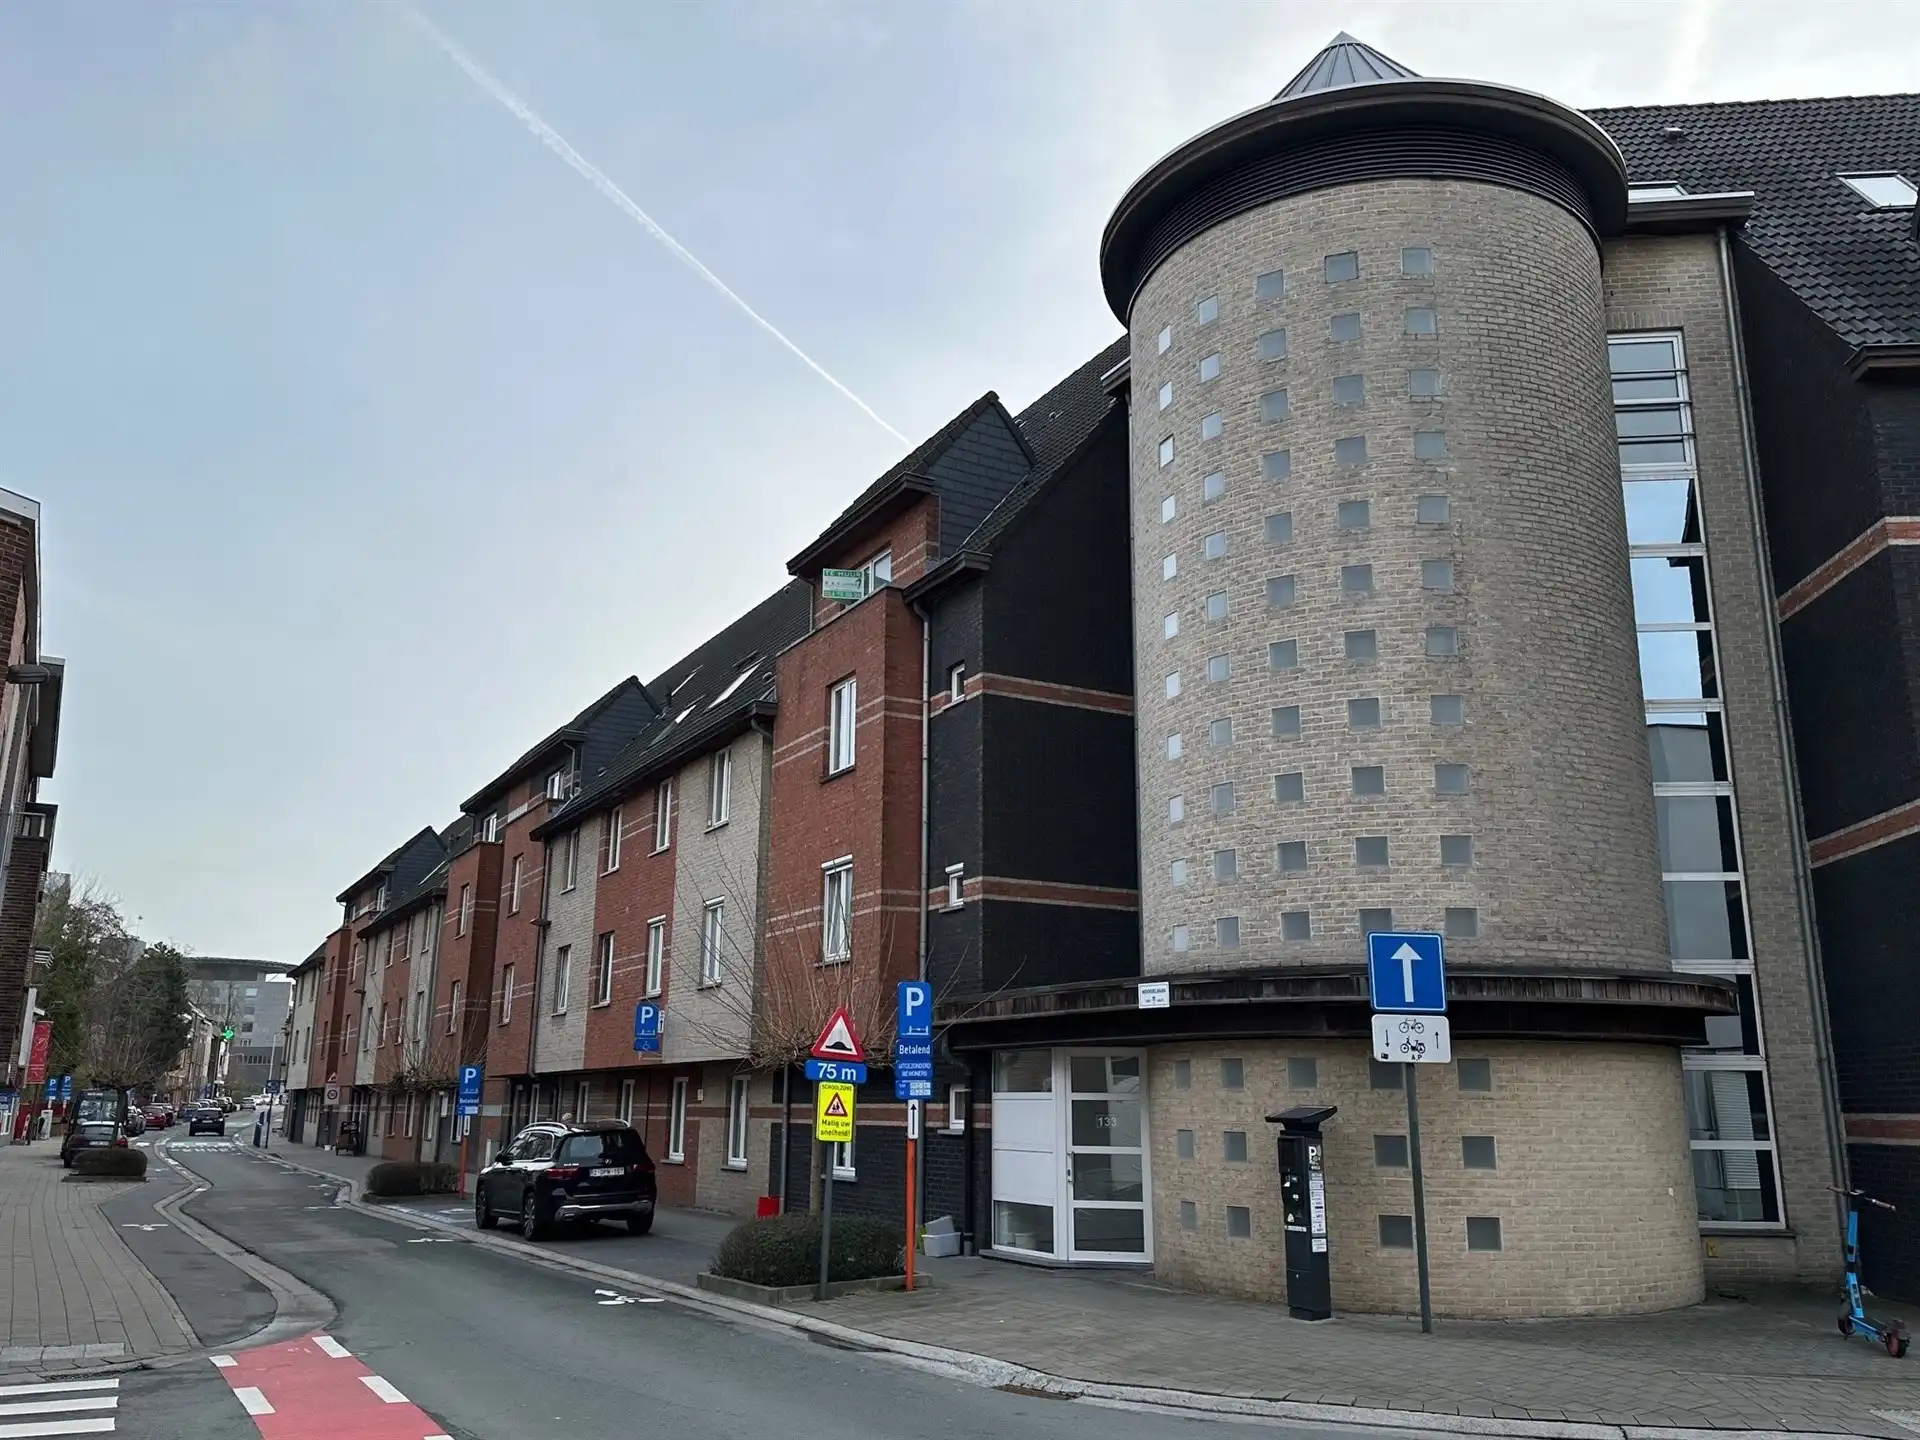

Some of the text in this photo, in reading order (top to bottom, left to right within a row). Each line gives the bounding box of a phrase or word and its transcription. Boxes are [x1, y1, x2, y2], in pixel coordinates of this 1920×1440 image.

[906, 987, 924, 1016] P
[641, 1006, 653, 1024] P
[899, 1044, 931, 1055] Betalend
[464, 1068, 477, 1083] P
[817, 1062, 857, 1081] 75 m
[49, 1079, 56, 1087] P
[64, 1075, 71, 1083] P
[821, 1119, 839, 1128] Matig
[1098, 1116, 1117, 1127] 133
[1308, 1146, 1317, 1163] P
